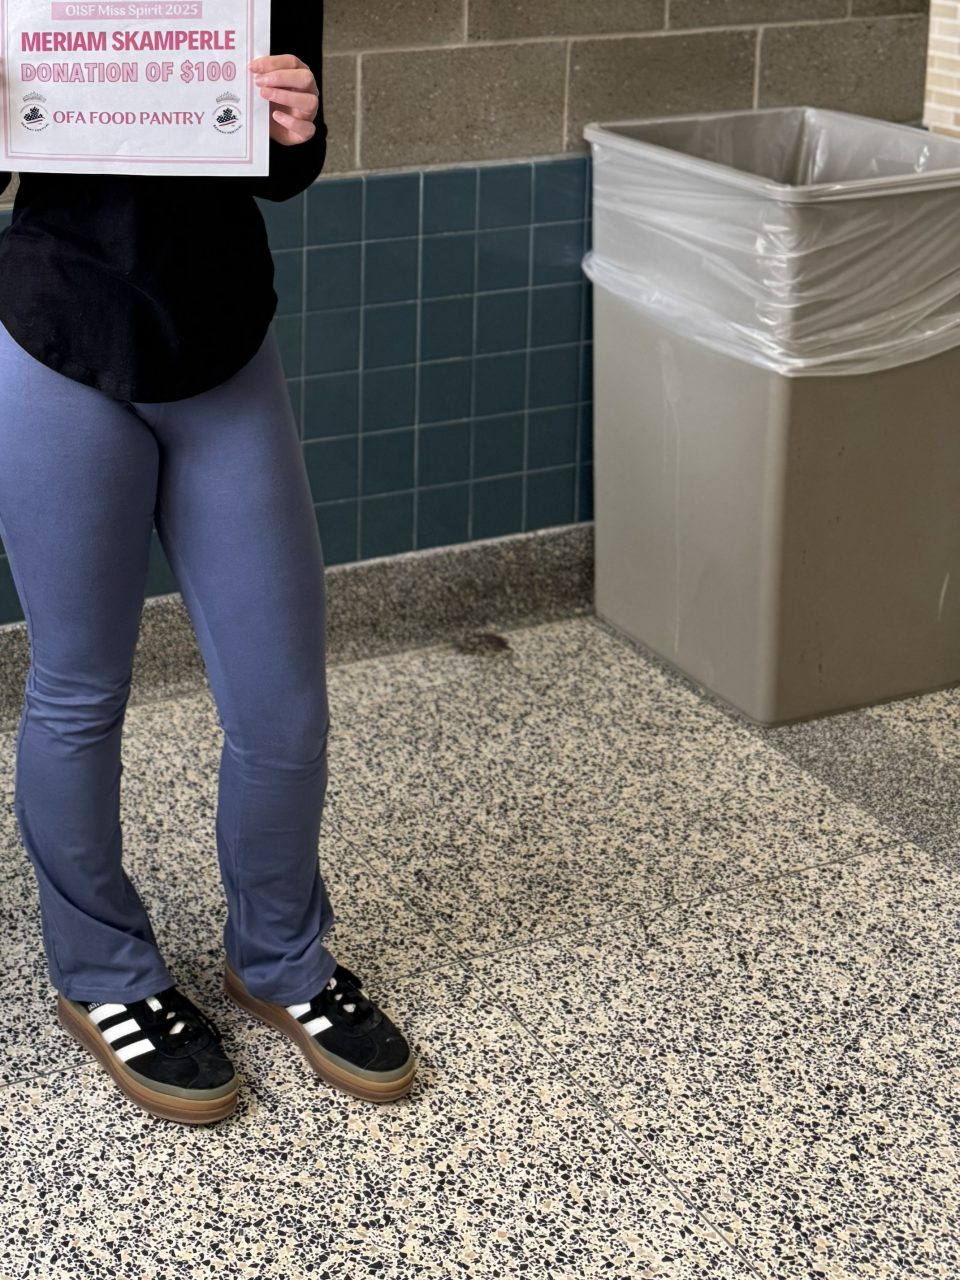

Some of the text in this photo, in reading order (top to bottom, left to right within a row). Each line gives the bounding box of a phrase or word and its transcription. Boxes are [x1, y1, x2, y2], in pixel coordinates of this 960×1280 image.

[65, 3, 198, 19] OISF Miss Spirit 2025
[21, 30, 236, 52] MERIAM SKAMPERLE
[21, 59, 237, 84] DONATION OF $100
[53, 110, 205, 125] OFA FOOD PANTRY
